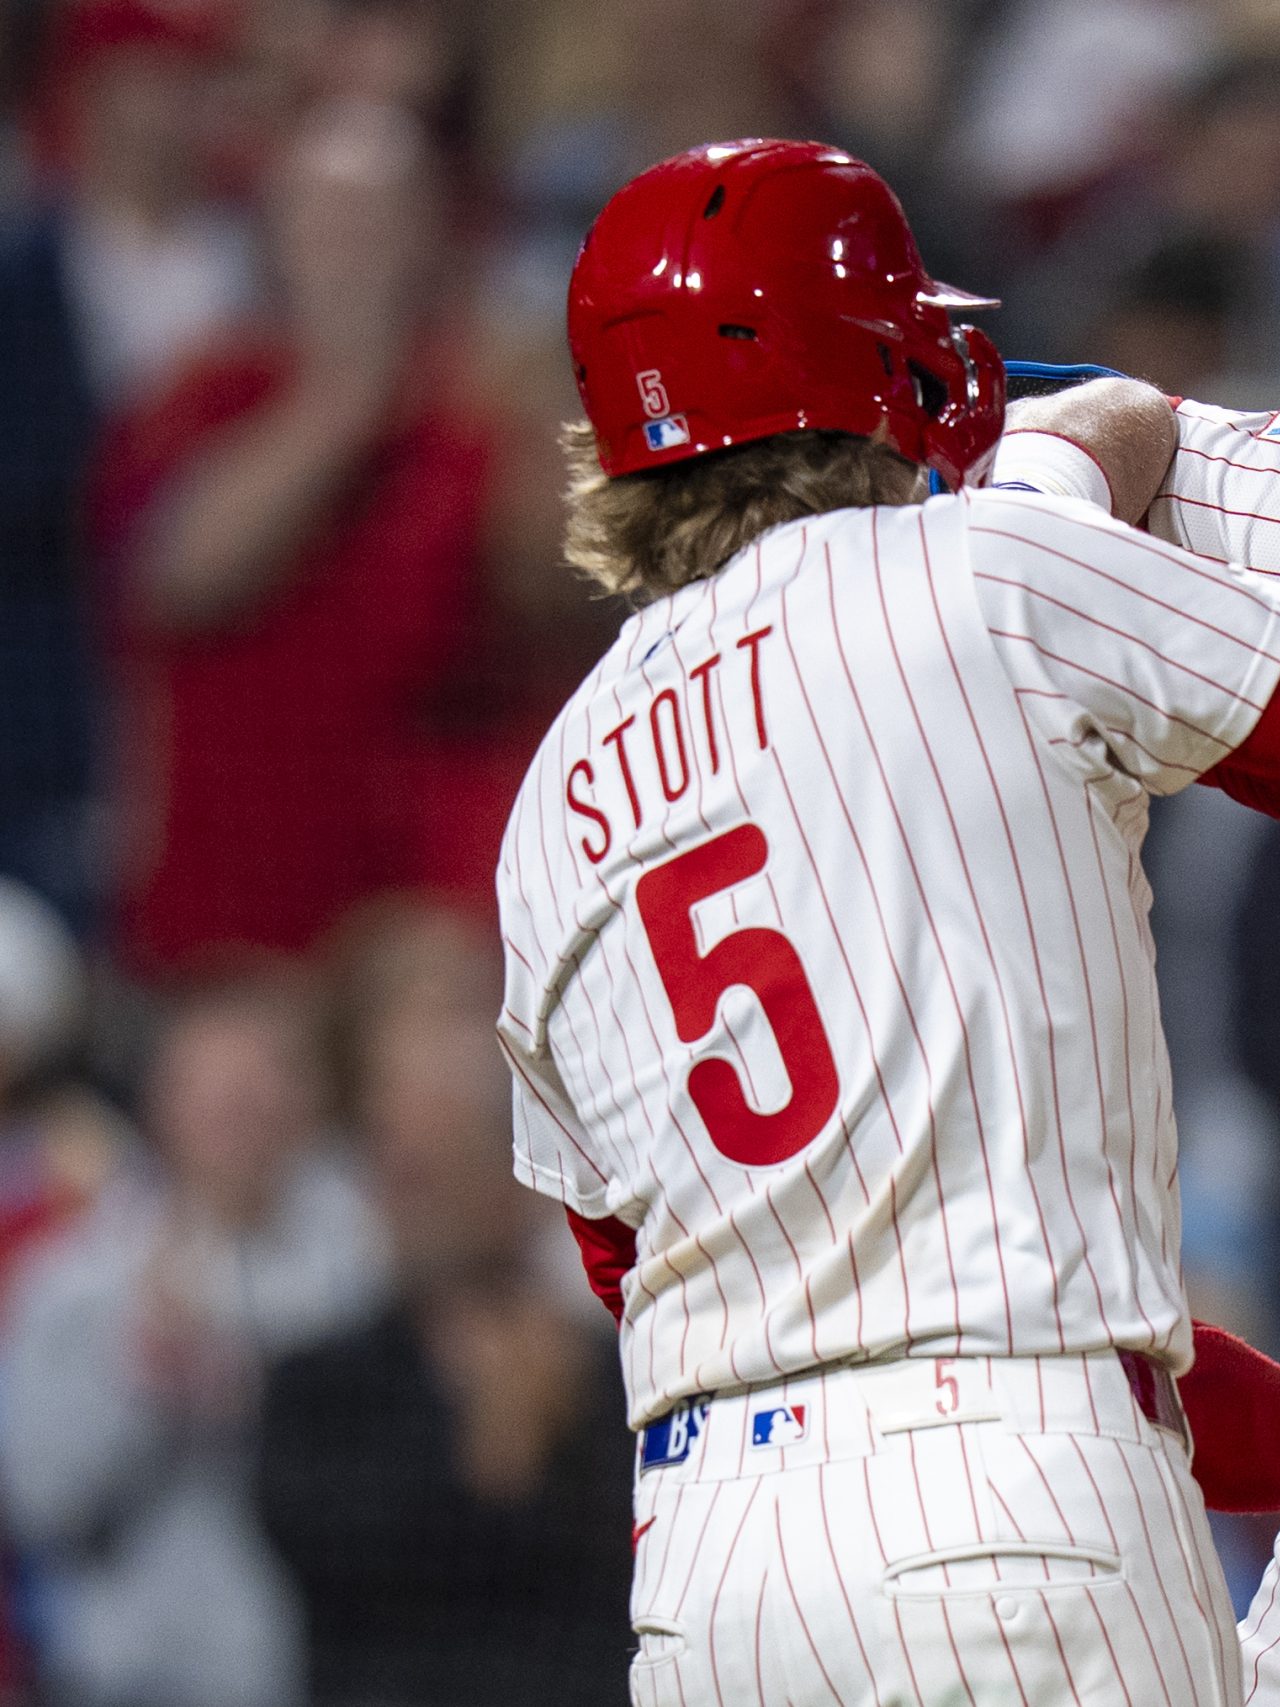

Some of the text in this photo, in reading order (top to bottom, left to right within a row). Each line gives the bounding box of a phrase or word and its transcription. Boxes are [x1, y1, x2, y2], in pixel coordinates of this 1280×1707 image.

[635, 368, 670, 419] 5
[566, 624, 773, 864] STOTT
[636, 822, 840, 1167] 5
[934, 1356, 959, 1417] 5
